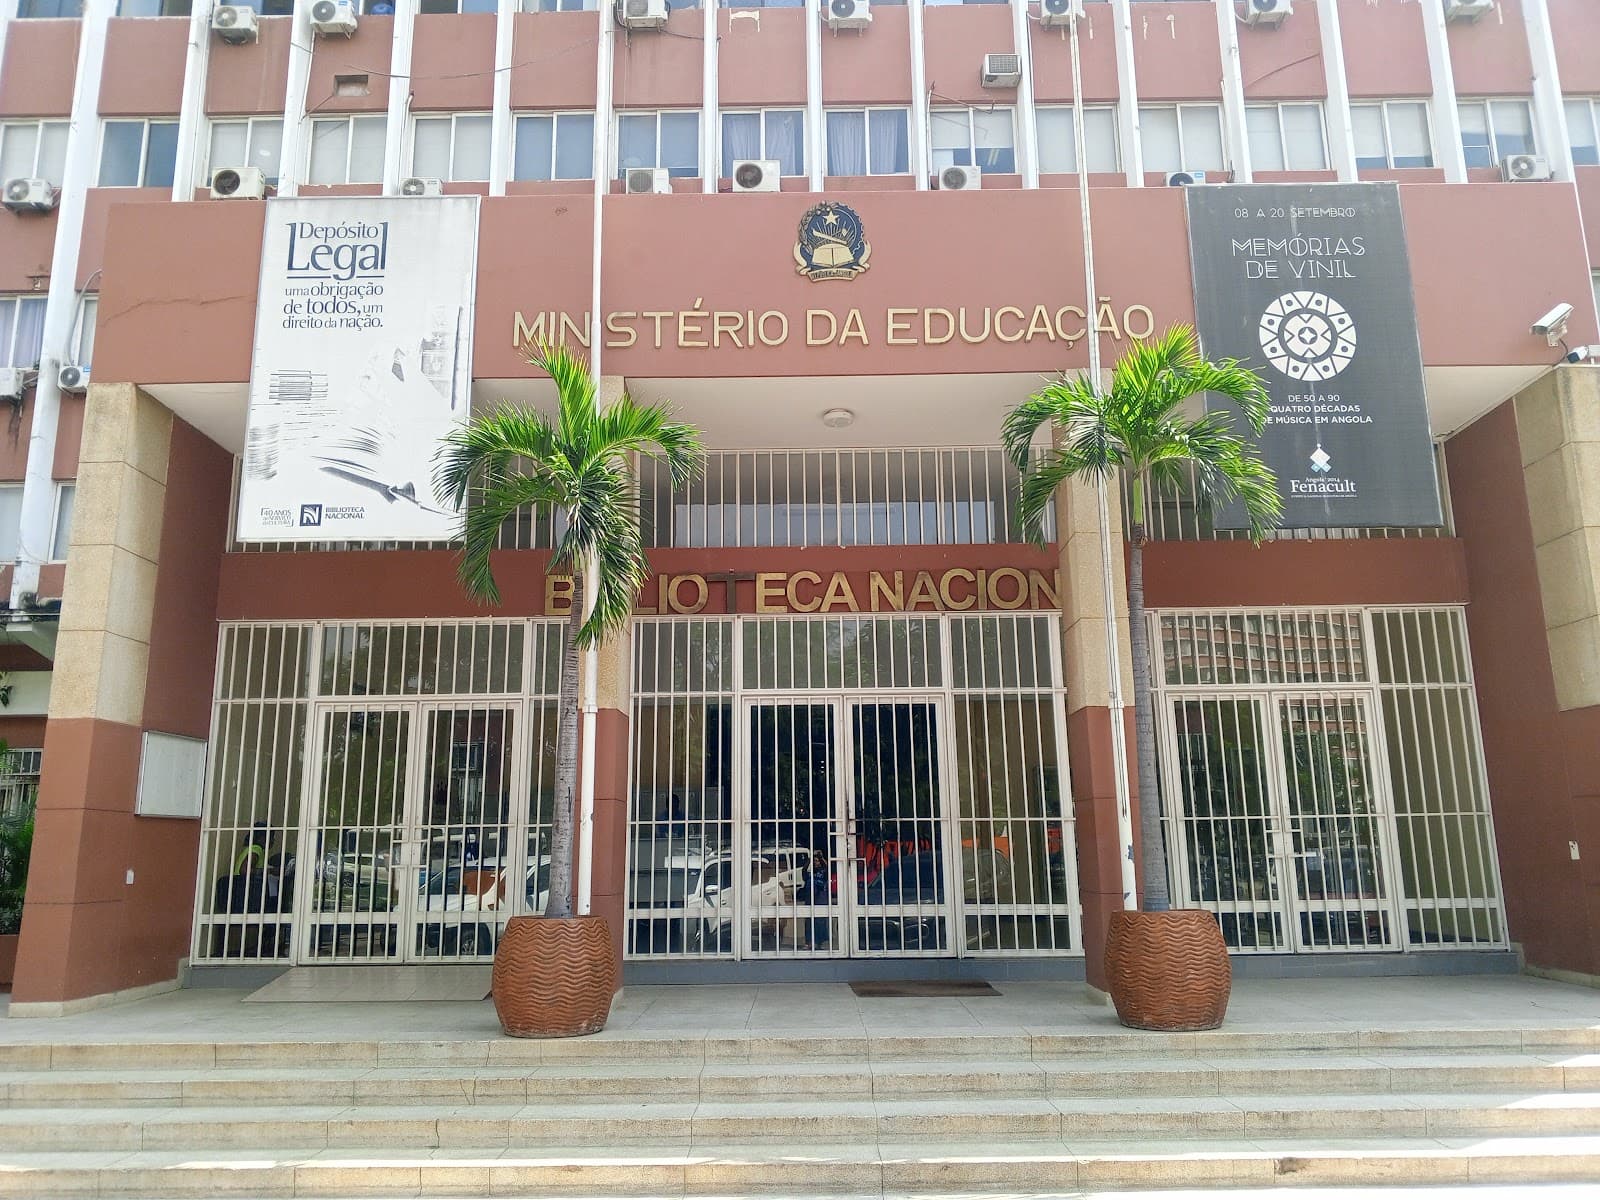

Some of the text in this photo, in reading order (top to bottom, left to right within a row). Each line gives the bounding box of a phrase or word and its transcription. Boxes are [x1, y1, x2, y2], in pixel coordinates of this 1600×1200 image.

[1234, 207, 1356, 218] 08 A 20 SETEMBRO
[299, 221, 379, 243] Depósito
[285, 221, 388, 281] Legal
[1231, 233, 1366, 257] MEMÓRIAS
[1245, 259, 1357, 279] DE VINIL
[285, 282, 384, 299] uma obrigação
[283, 296, 383, 316] de todos, um
[282, 315, 384, 331] direito da nação.
[512, 296, 1155, 350] MINSTÉRIO DA EDUCAÇÃO
[1270, 403, 1361, 413] QUATRO DÉCADAS
[1275, 415, 1312, 424] MÚSICA
[1315, 416, 1329, 424] EM
[1331, 416, 1373, 424] ANGOLA
[1290, 479, 1357, 493] Fenacult
[544, 570, 860, 616] BLIOTECA
